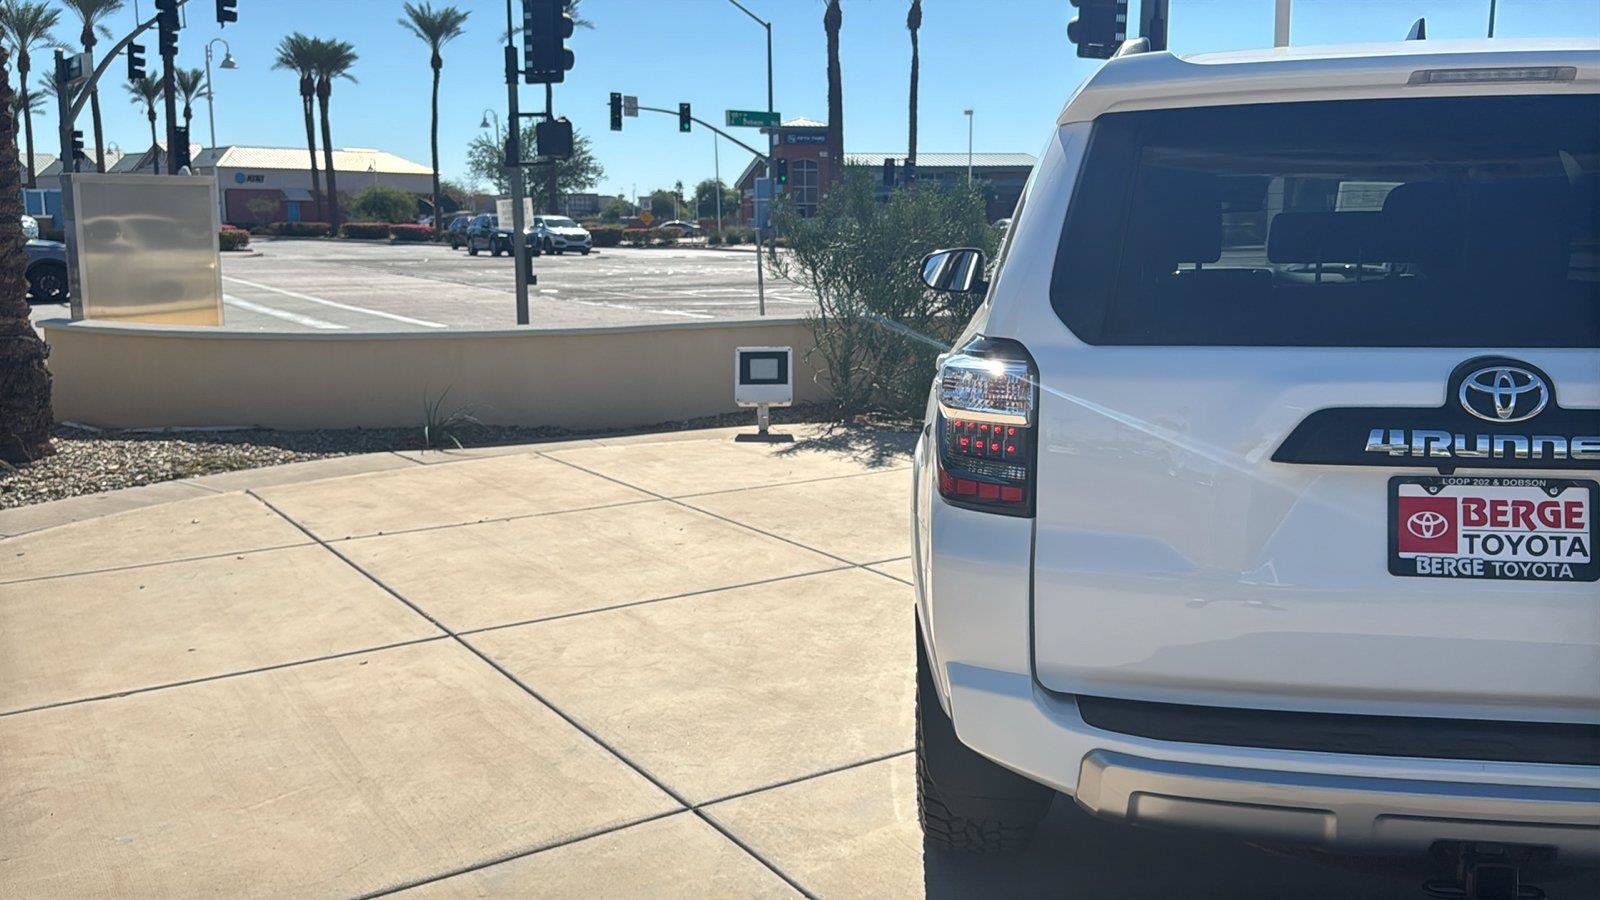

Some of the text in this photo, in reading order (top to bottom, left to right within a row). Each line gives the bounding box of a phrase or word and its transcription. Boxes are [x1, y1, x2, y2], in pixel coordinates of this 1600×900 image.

[247, 175, 264, 183] AT&T
[1442, 477, 1547, 487] LOOP 202 & DOBSON
[1461, 497, 1585, 532] BERGE
[1462, 533, 1589, 558] TOYOTA
[1416, 556, 1574, 579] BERGE TOYOTA
